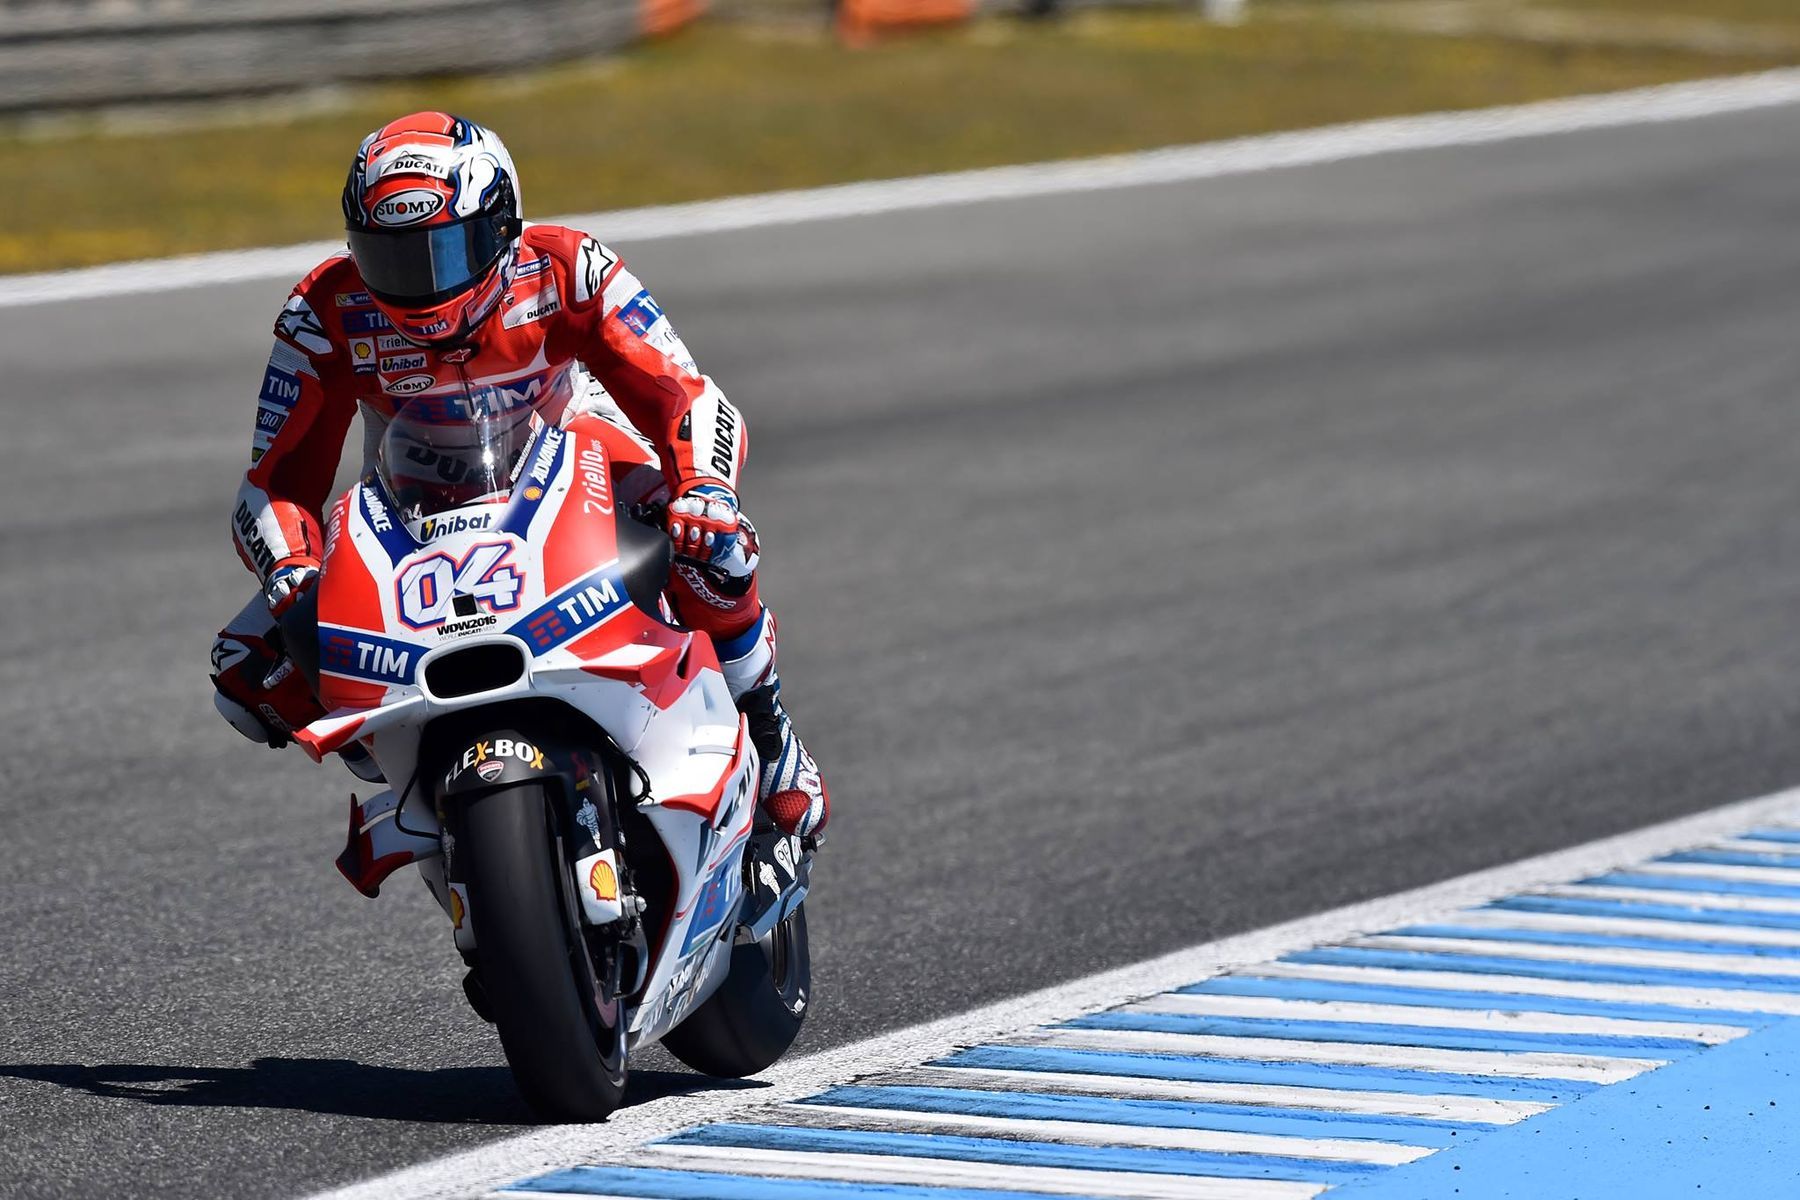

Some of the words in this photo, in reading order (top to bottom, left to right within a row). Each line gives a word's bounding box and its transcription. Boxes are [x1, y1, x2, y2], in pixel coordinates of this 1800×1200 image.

[394, 160, 444, 175] DUCATI
[377, 199, 438, 216] SUOMY
[527, 301, 558, 319] DUCATI
[421, 321, 448, 335] TIM
[382, 356, 425, 372] Unibat
[268, 376, 300, 401] TIM
[454, 377, 542, 420] TIM
[711, 398, 737, 480] DUCATI
[531, 427, 564, 485] ADVANCE
[420, 513, 491, 542] Unibat
[394, 539, 527, 632] 04
[557, 578, 620, 625] TIM
[436, 615, 498, 636] WDW2016
[357, 641, 410, 678] TIM
[444, 738, 545, 792] FLEX-BOX
